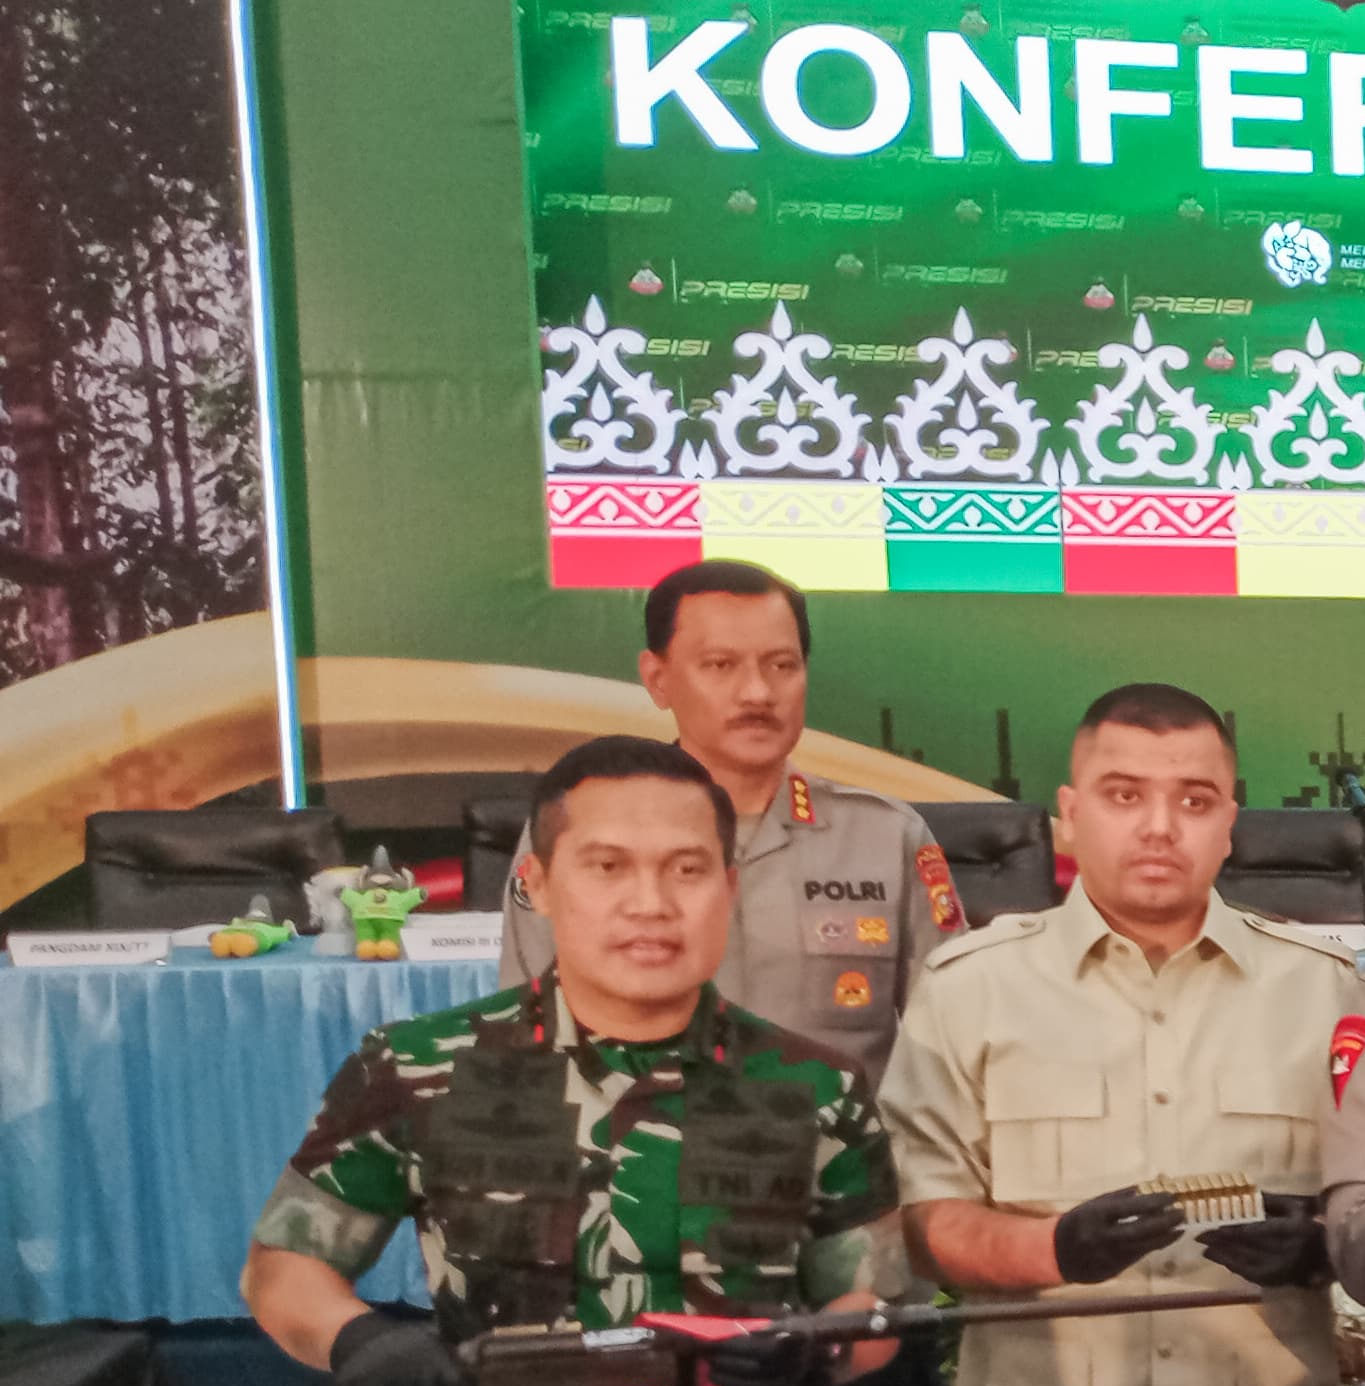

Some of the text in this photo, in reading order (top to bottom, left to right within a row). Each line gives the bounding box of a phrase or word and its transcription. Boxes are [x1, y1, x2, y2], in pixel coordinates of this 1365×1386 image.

[680, 280, 810, 301] PRESISI
[1131, 295, 1254, 317] PRESISI
[804, 880, 887, 901] POLRI
